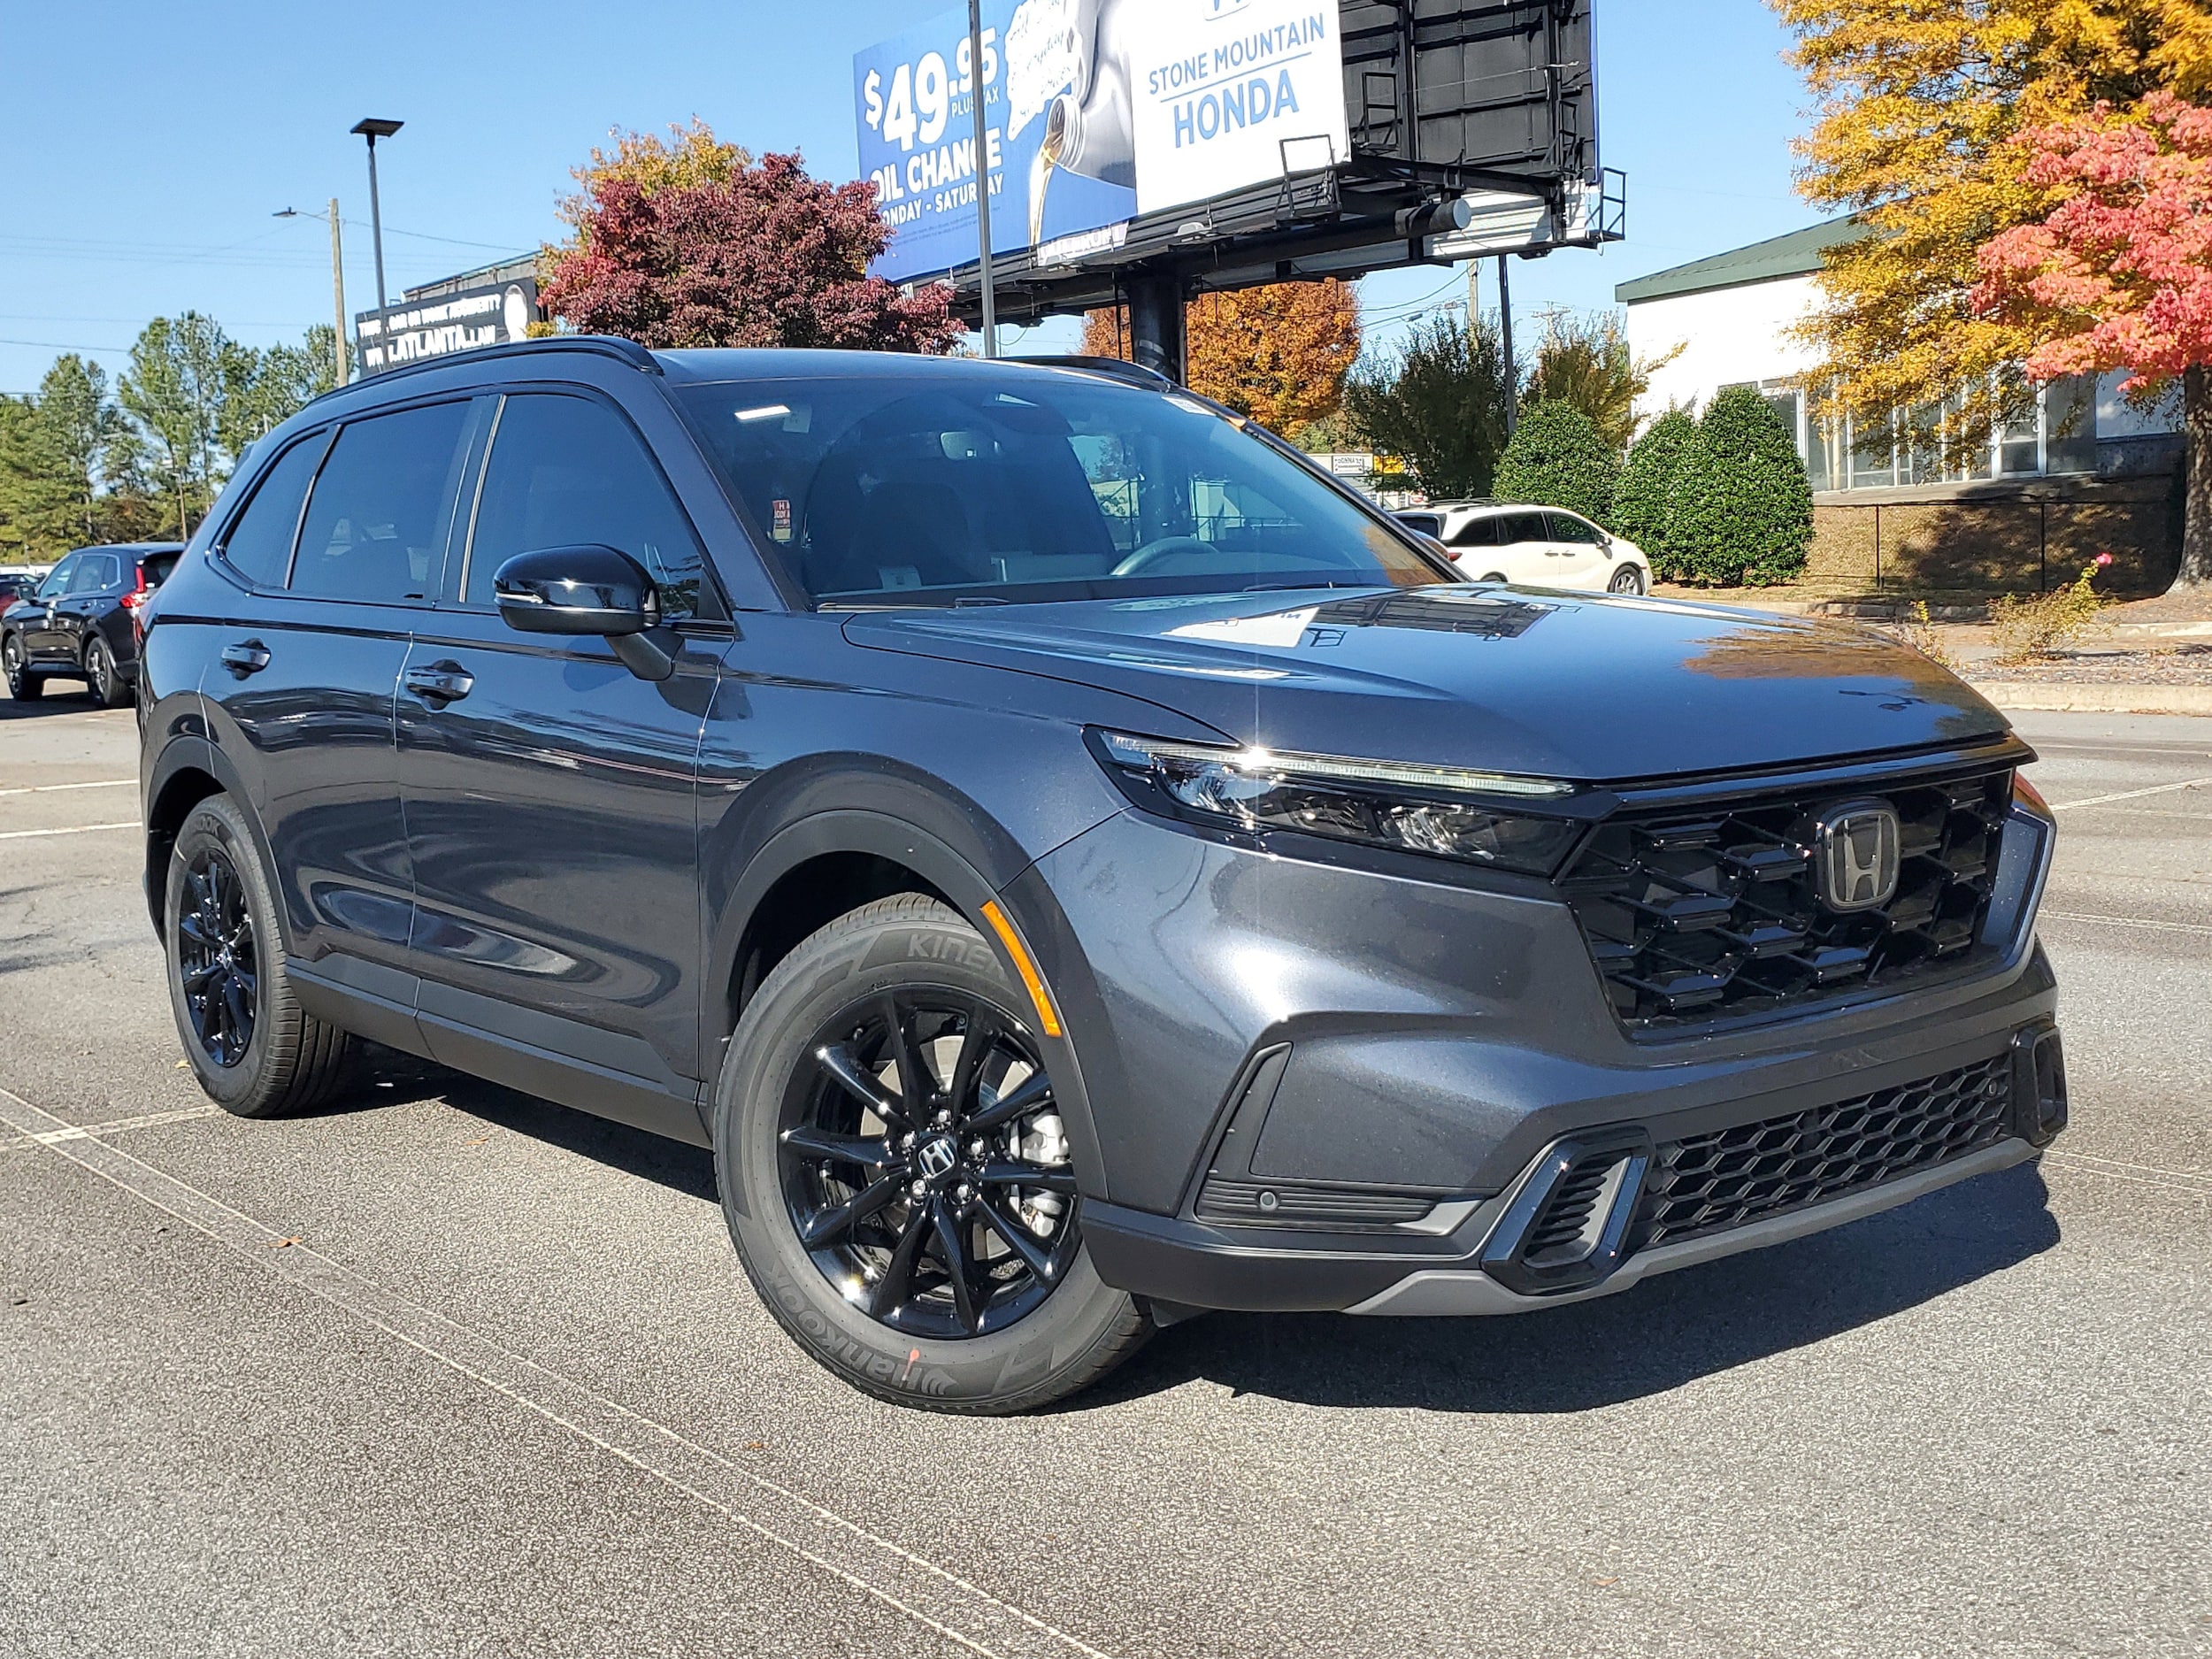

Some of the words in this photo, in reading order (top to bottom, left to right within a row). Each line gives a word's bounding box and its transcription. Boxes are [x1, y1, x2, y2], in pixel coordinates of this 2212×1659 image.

[1149, 52, 1209, 95] STONE
[1214, 12, 1325, 73] MOUNTAIN
[863, 27, 999, 153] $49.95
[983, 86, 1000, 106] AX
[1173, 69, 1300, 149] HONDA
[871, 163, 904, 203] OIL
[882, 198, 922, 227] ONDAY
[934, 173, 1003, 213] SATURAY
